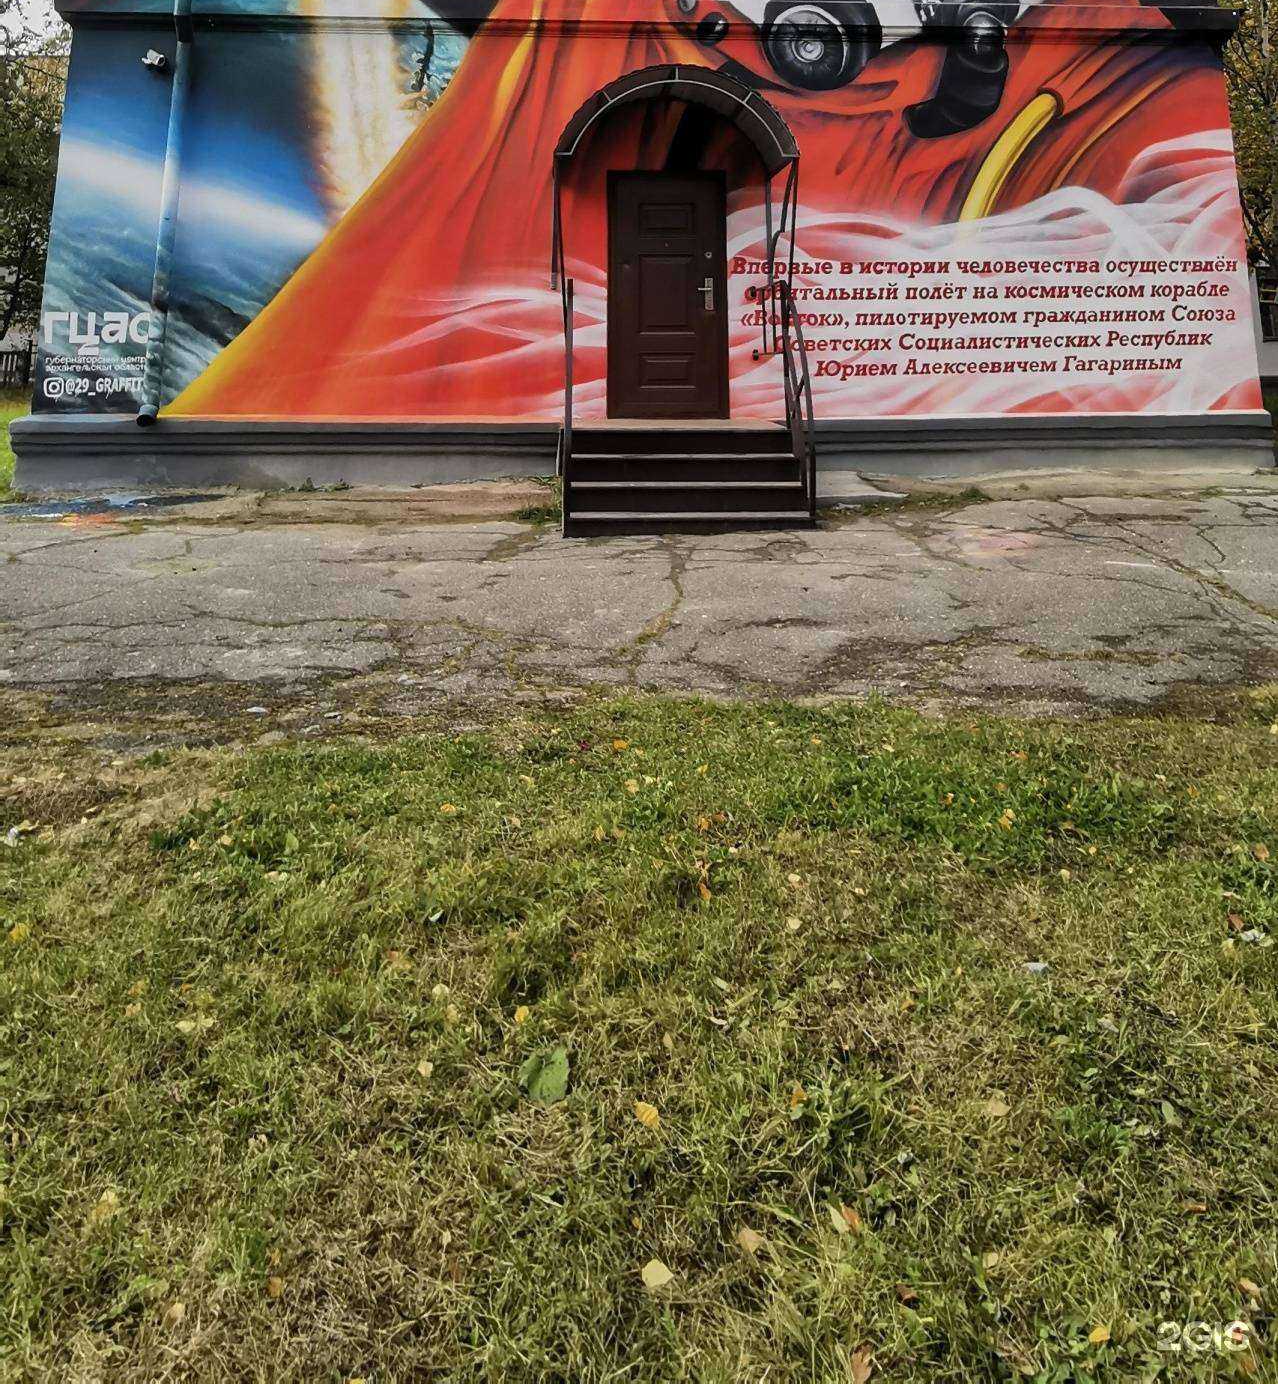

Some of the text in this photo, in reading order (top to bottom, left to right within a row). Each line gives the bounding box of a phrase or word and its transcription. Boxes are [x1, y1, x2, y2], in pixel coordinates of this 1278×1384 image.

[731, 255, 1239, 279] Впервые в истории человечества осуществлён
[905, 283, 967, 301] полёт
[973, 285, 998, 300] на
[1004, 284, 1145, 300] космическом
[1150, 280, 1230, 302] корабле
[741, 304, 1237, 329] «Воток», пилотируемом гражданином Союза
[899, 333, 1101, 354] Социалистических
[1106, 330, 1214, 350] Республик
[814, 356, 1183, 382] Юрием Алексеевичем Гагариным
